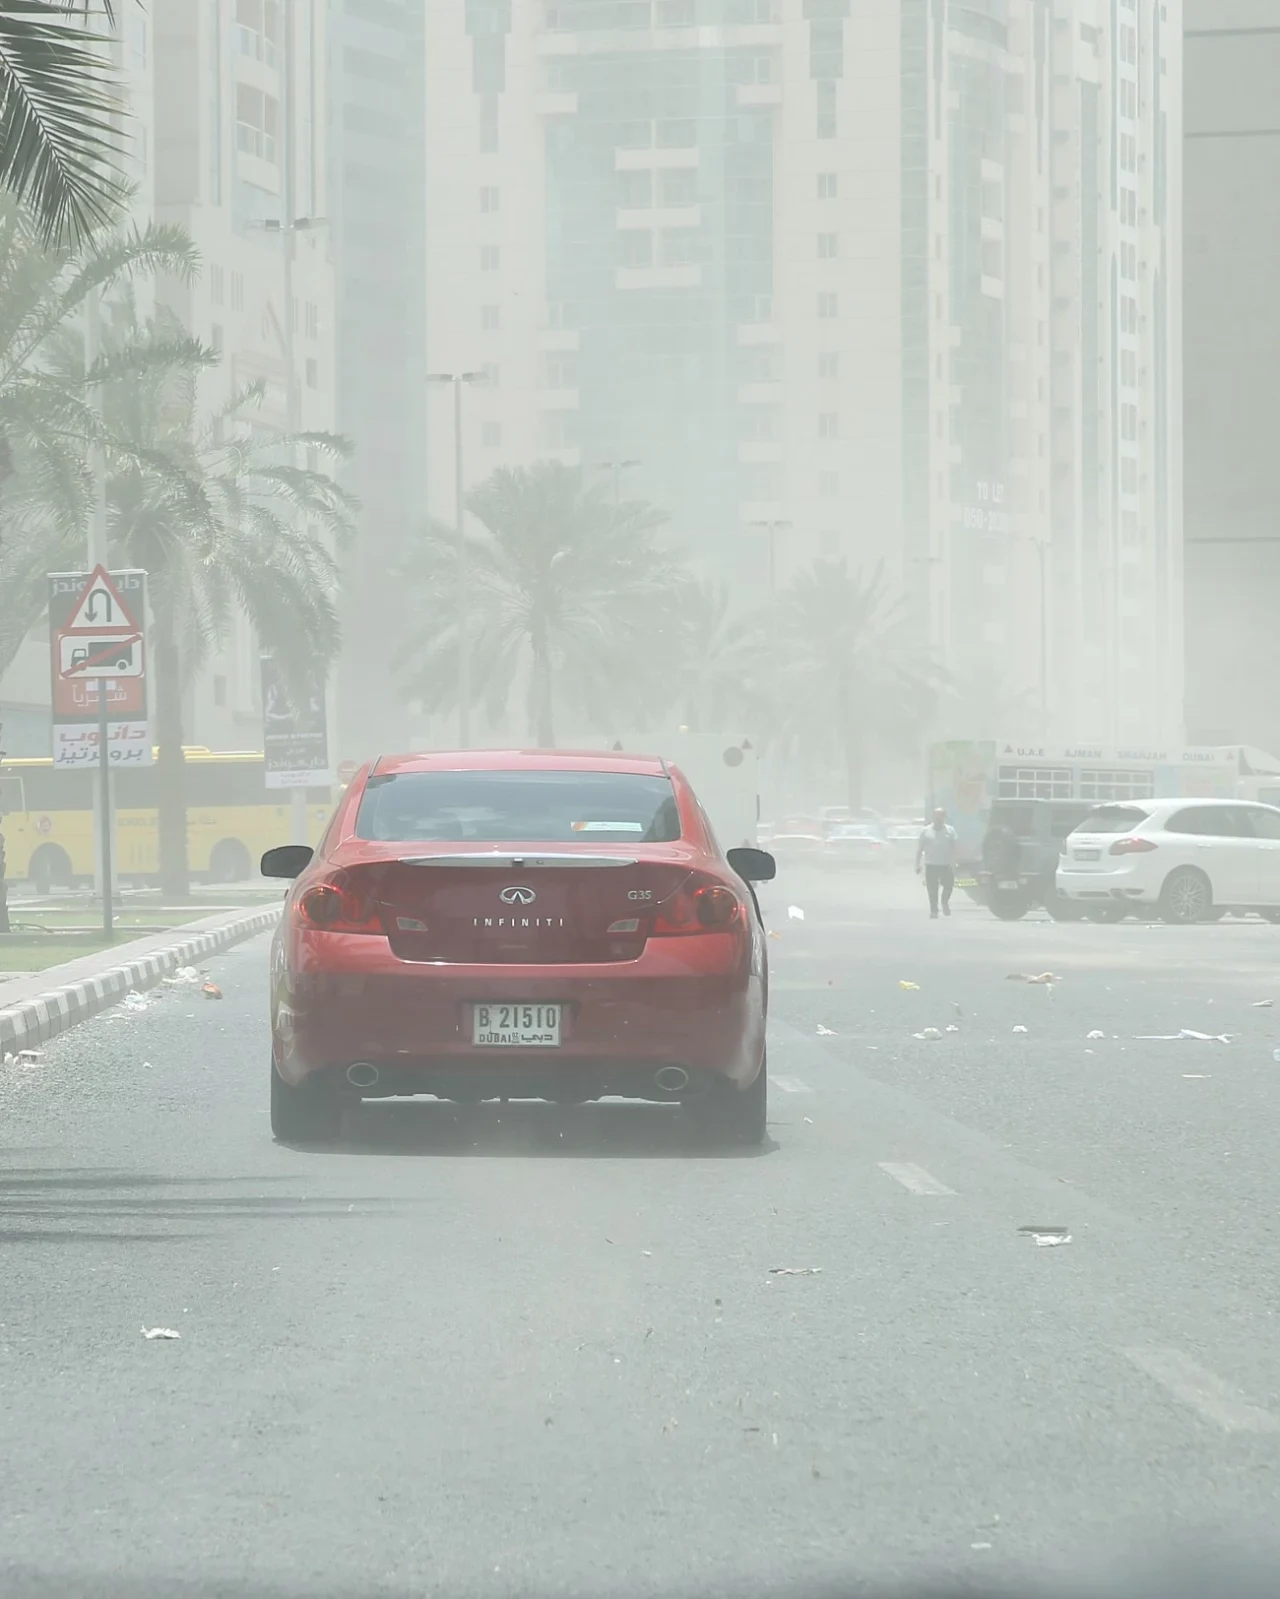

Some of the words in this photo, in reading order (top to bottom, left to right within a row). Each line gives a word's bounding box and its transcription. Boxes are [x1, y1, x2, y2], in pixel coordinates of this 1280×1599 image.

[52, 574, 141, 597] دايوندز
[473, 918, 564, 927] INFINITI
[479, 1007, 489, 1028] B
[499, 1007, 556, 1028] 21510
[479, 1033, 511, 1043] DUBAI
[521, 1034, 553, 1043] دبي
